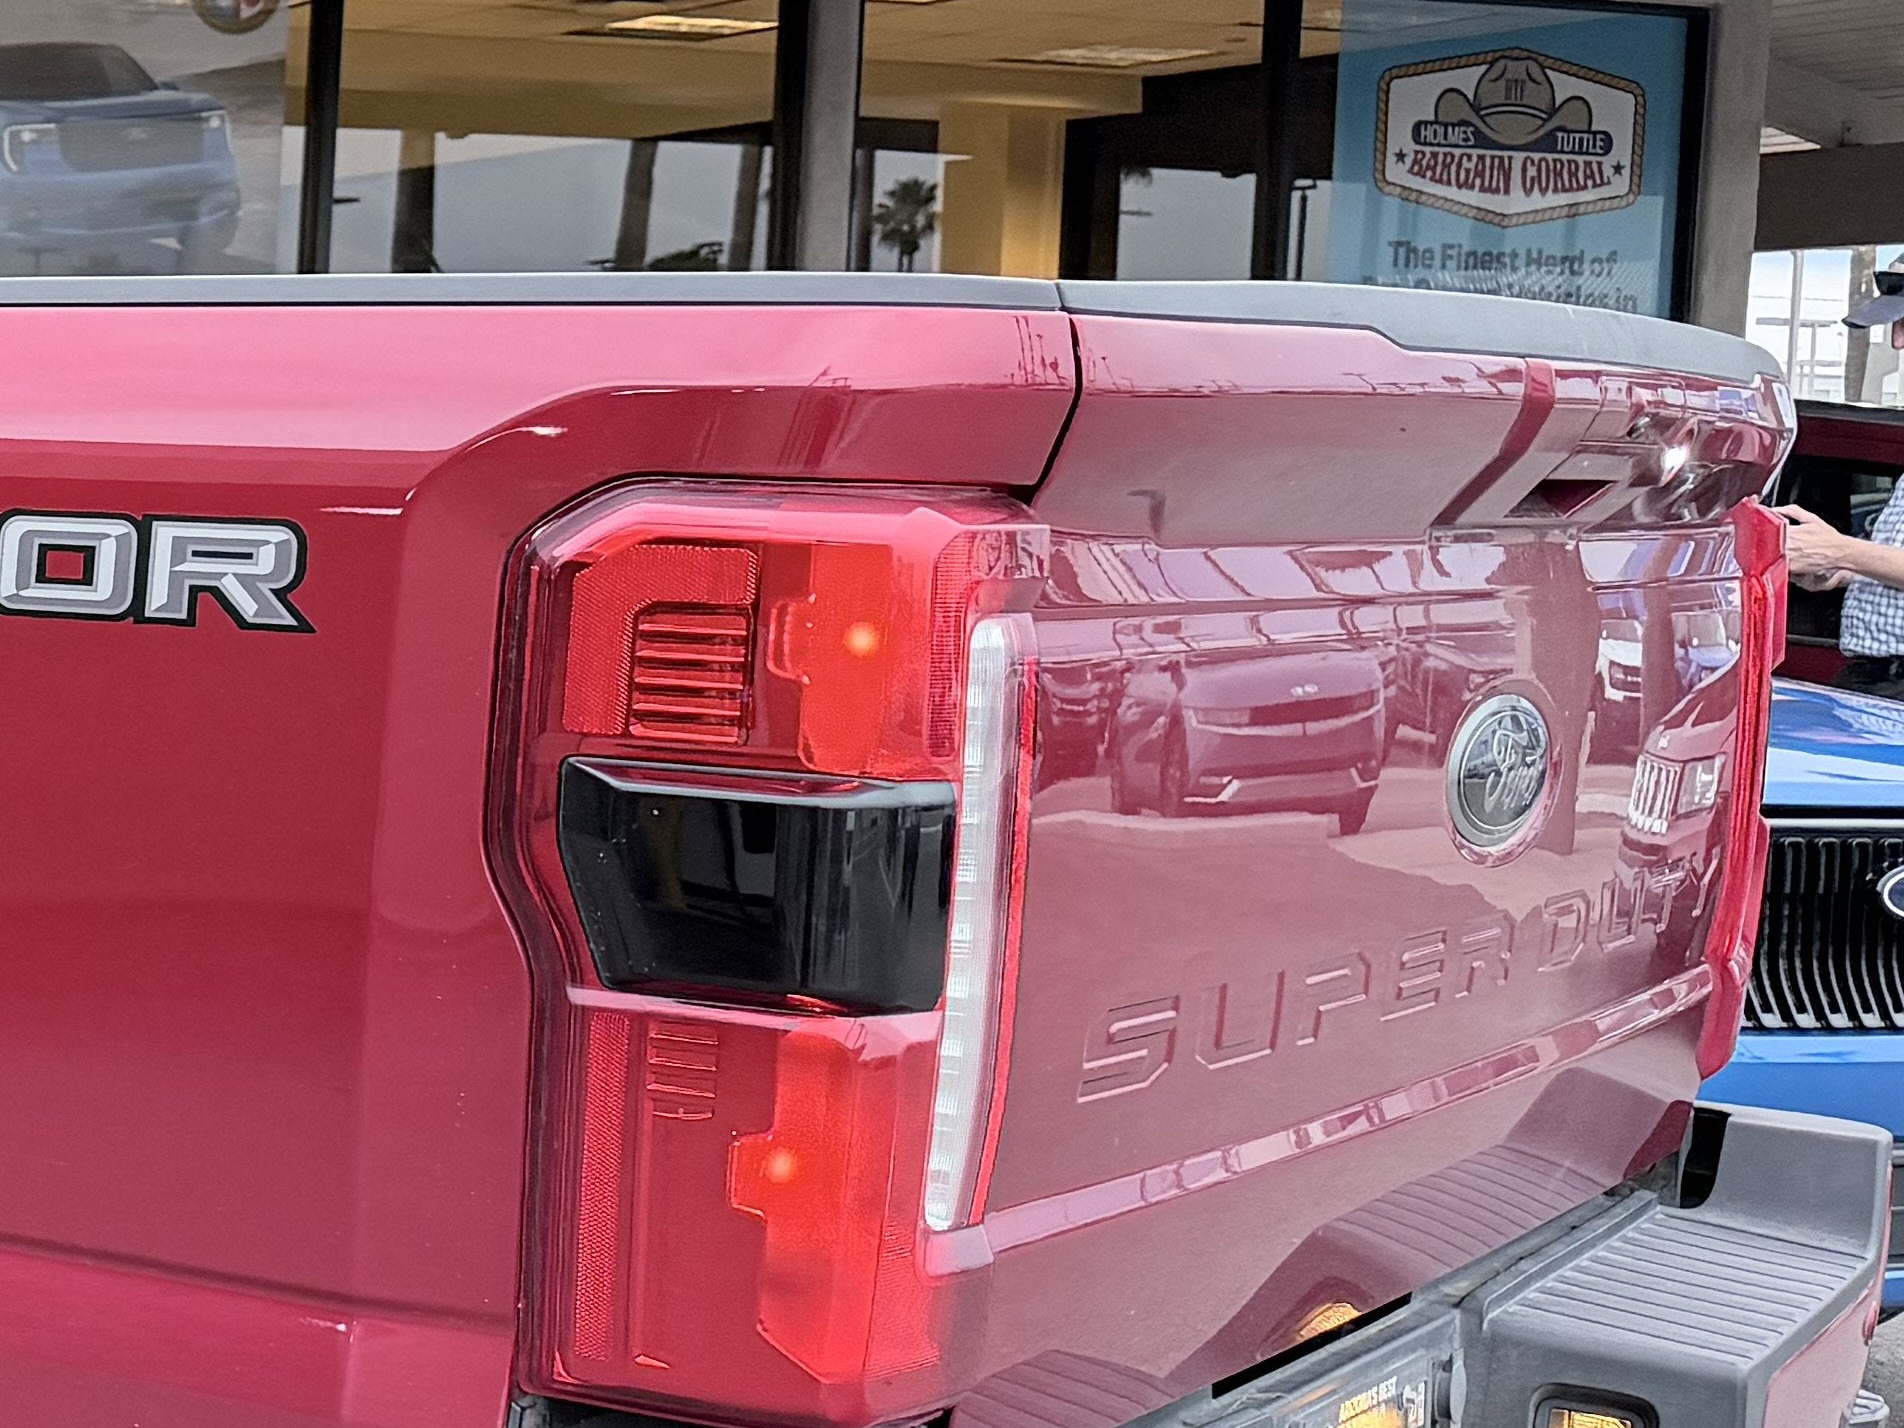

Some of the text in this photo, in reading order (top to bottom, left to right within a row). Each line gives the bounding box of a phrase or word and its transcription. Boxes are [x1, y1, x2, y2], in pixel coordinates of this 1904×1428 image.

[1420, 123, 1605, 153] HOLMES TUTTLE
[1407, 149, 1612, 198] BARGAIN CORRAL
[1388, 239, 1618, 277] The Finest Herd of
[1485, 729, 1542, 813] Ford
[1076, 844, 1721, 1104] SUPER DUTY
